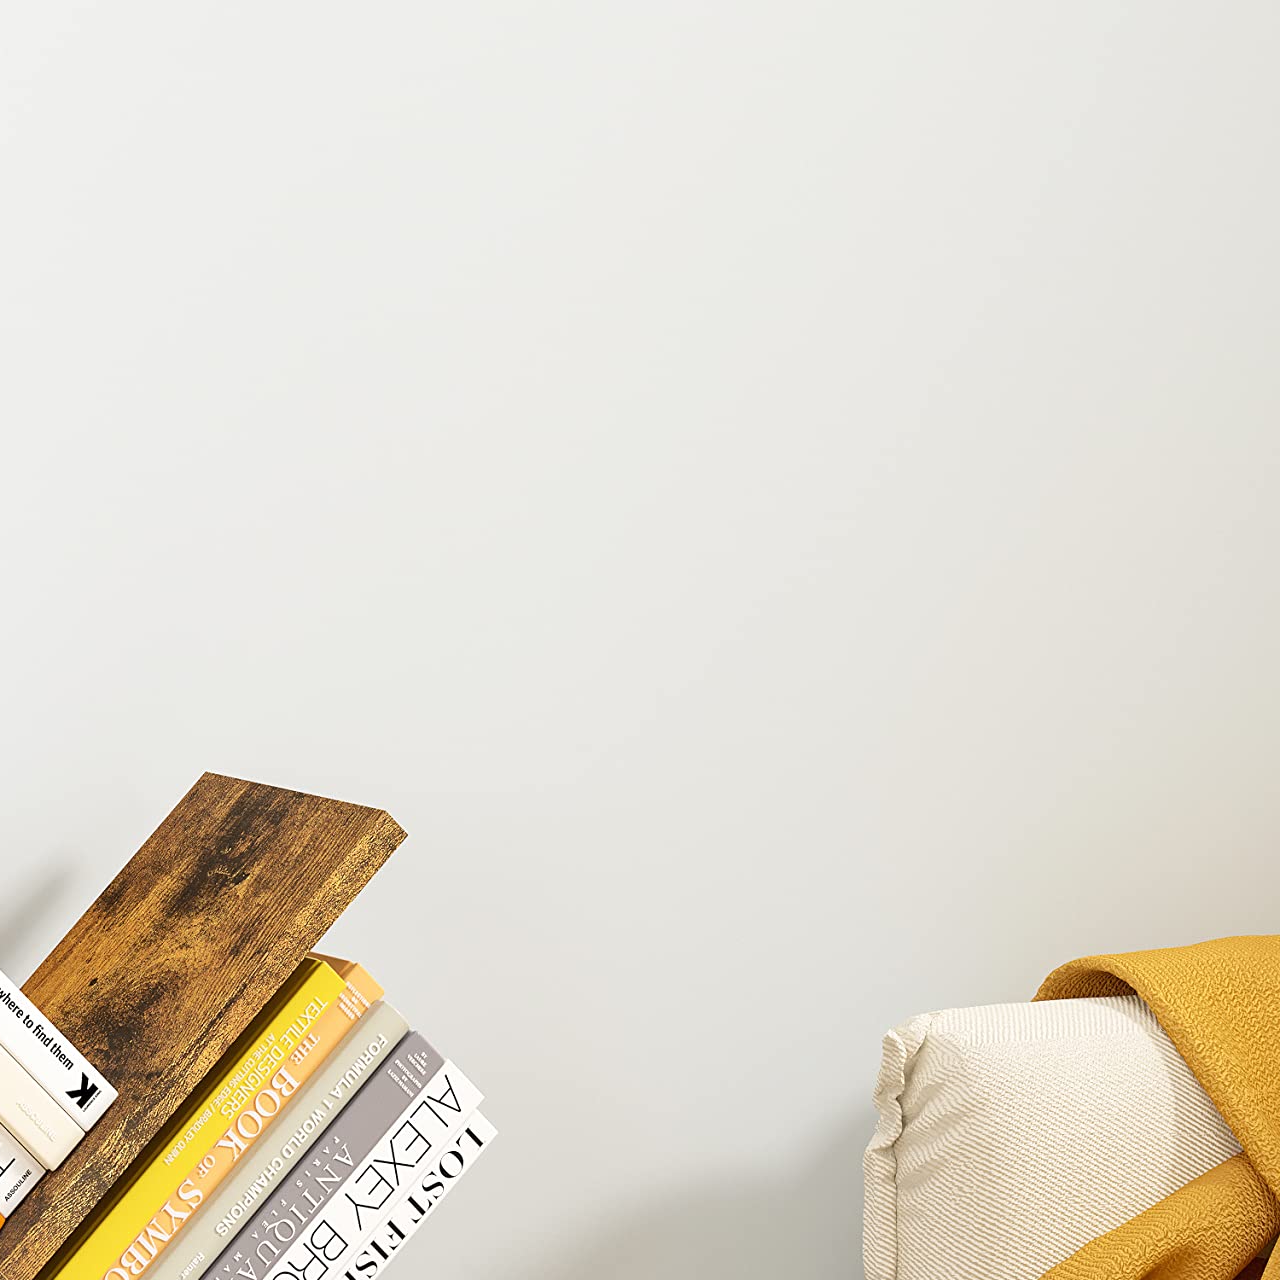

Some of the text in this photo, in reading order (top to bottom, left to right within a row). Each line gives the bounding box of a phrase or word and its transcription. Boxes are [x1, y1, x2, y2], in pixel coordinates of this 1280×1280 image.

[20, 1012, 37, 1029] to
[31, 1023, 55, 1047] find
[48, 1041, 77, 1070] them
[251, 1042, 267, 1060] THE
[262, 1031, 276, 1046] AT
[288, 1030, 320, 1065] THE
[218, 993, 328, 1120] TEXTILE DESIGNERS
[227, 1056, 255, 1088] CUTTING
[63, 1071, 100, 1109] K
[211, 1085, 231, 1107] EDGE
[181, 1107, 212, 1142] BRADLEY
[214, 1064, 302, 1162] BOOK
[162, 1138, 186, 1165] QUINN
[213, 1032, 389, 1237] FORMULA 1 WORLD CHAMPIONS
[332, 1074, 472, 1230] ALEXEY
[193, 1152, 218, 1179] OF
[294, 1134, 341, 1188] PARIS
[398, 1126, 485, 1224] LOST
[0, 1168, 35, 1202] ASSOULINE
[250, 1198, 287, 1240] FLEA
[178, 1251, 205, 1280] Rainer
